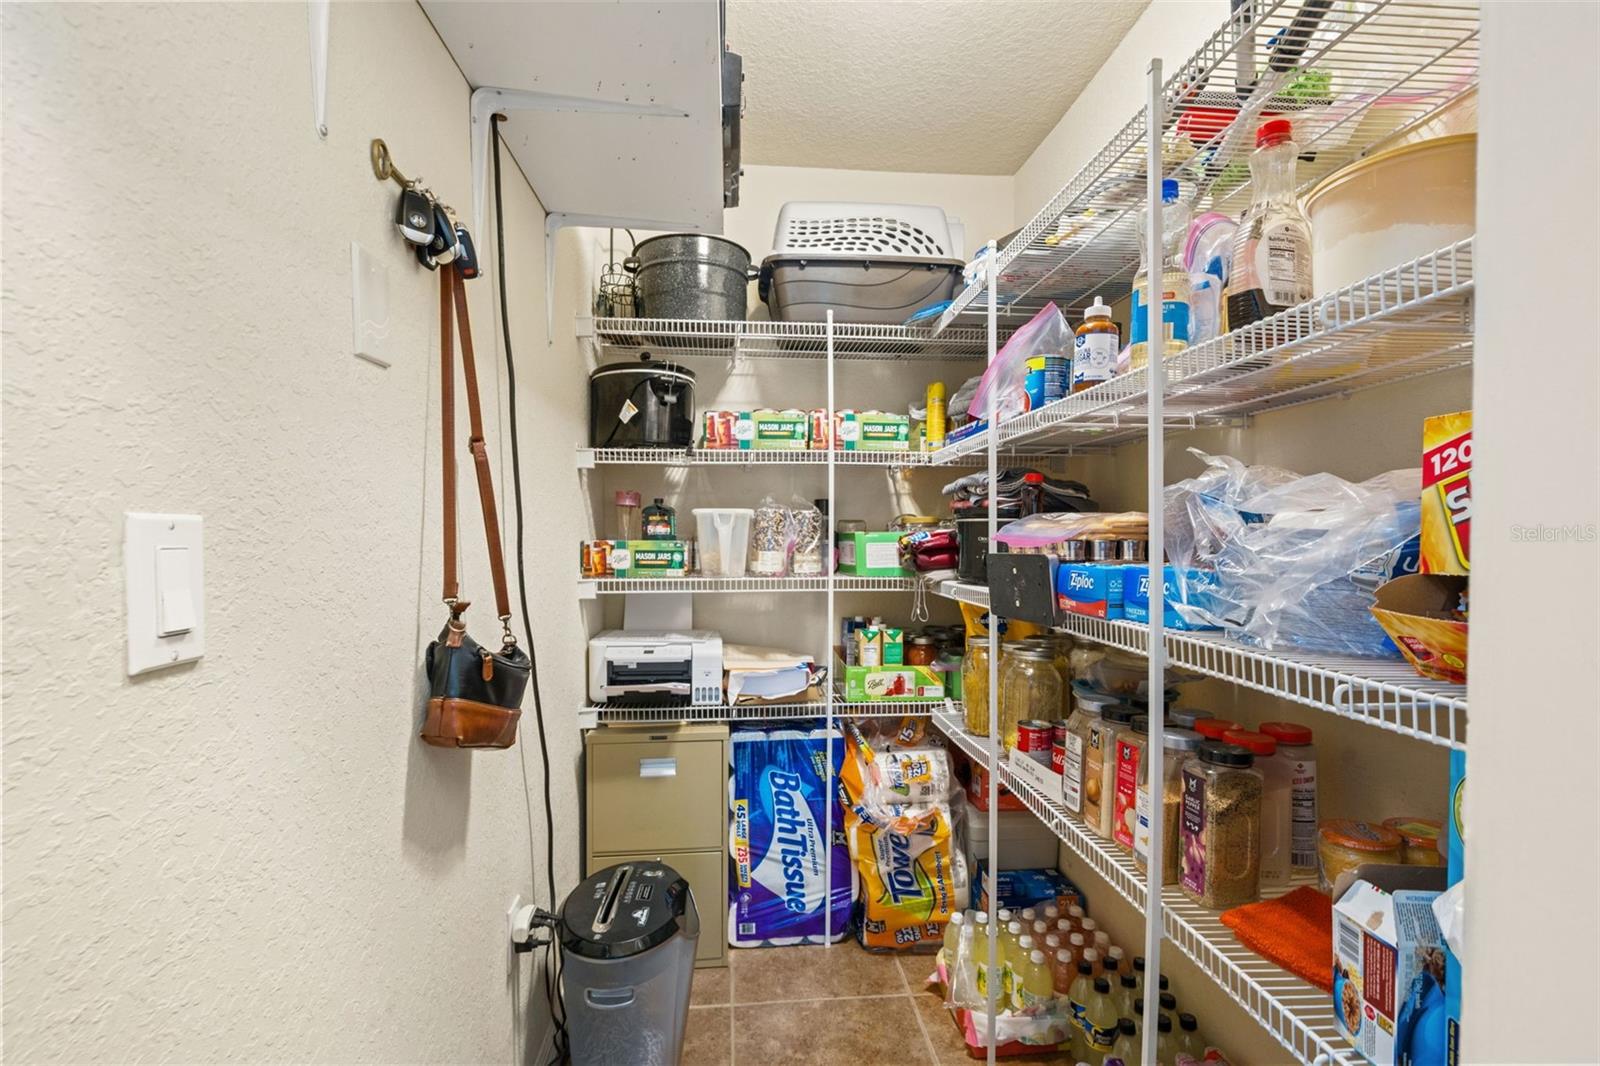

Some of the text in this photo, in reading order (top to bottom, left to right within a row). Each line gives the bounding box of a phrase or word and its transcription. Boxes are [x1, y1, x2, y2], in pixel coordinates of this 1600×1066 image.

[759, 423, 794, 431] MASON JARS
[863, 424, 898, 432] MASON JARS
[635, 552, 671, 560] MASON JARS
[1069, 571, 1095, 591] Ziploc
[736, 804, 746, 819] 45
[806, 818, 820, 876] Ultra Premium
[737, 847, 748, 863] 235
[887, 834, 923, 904] Towe
